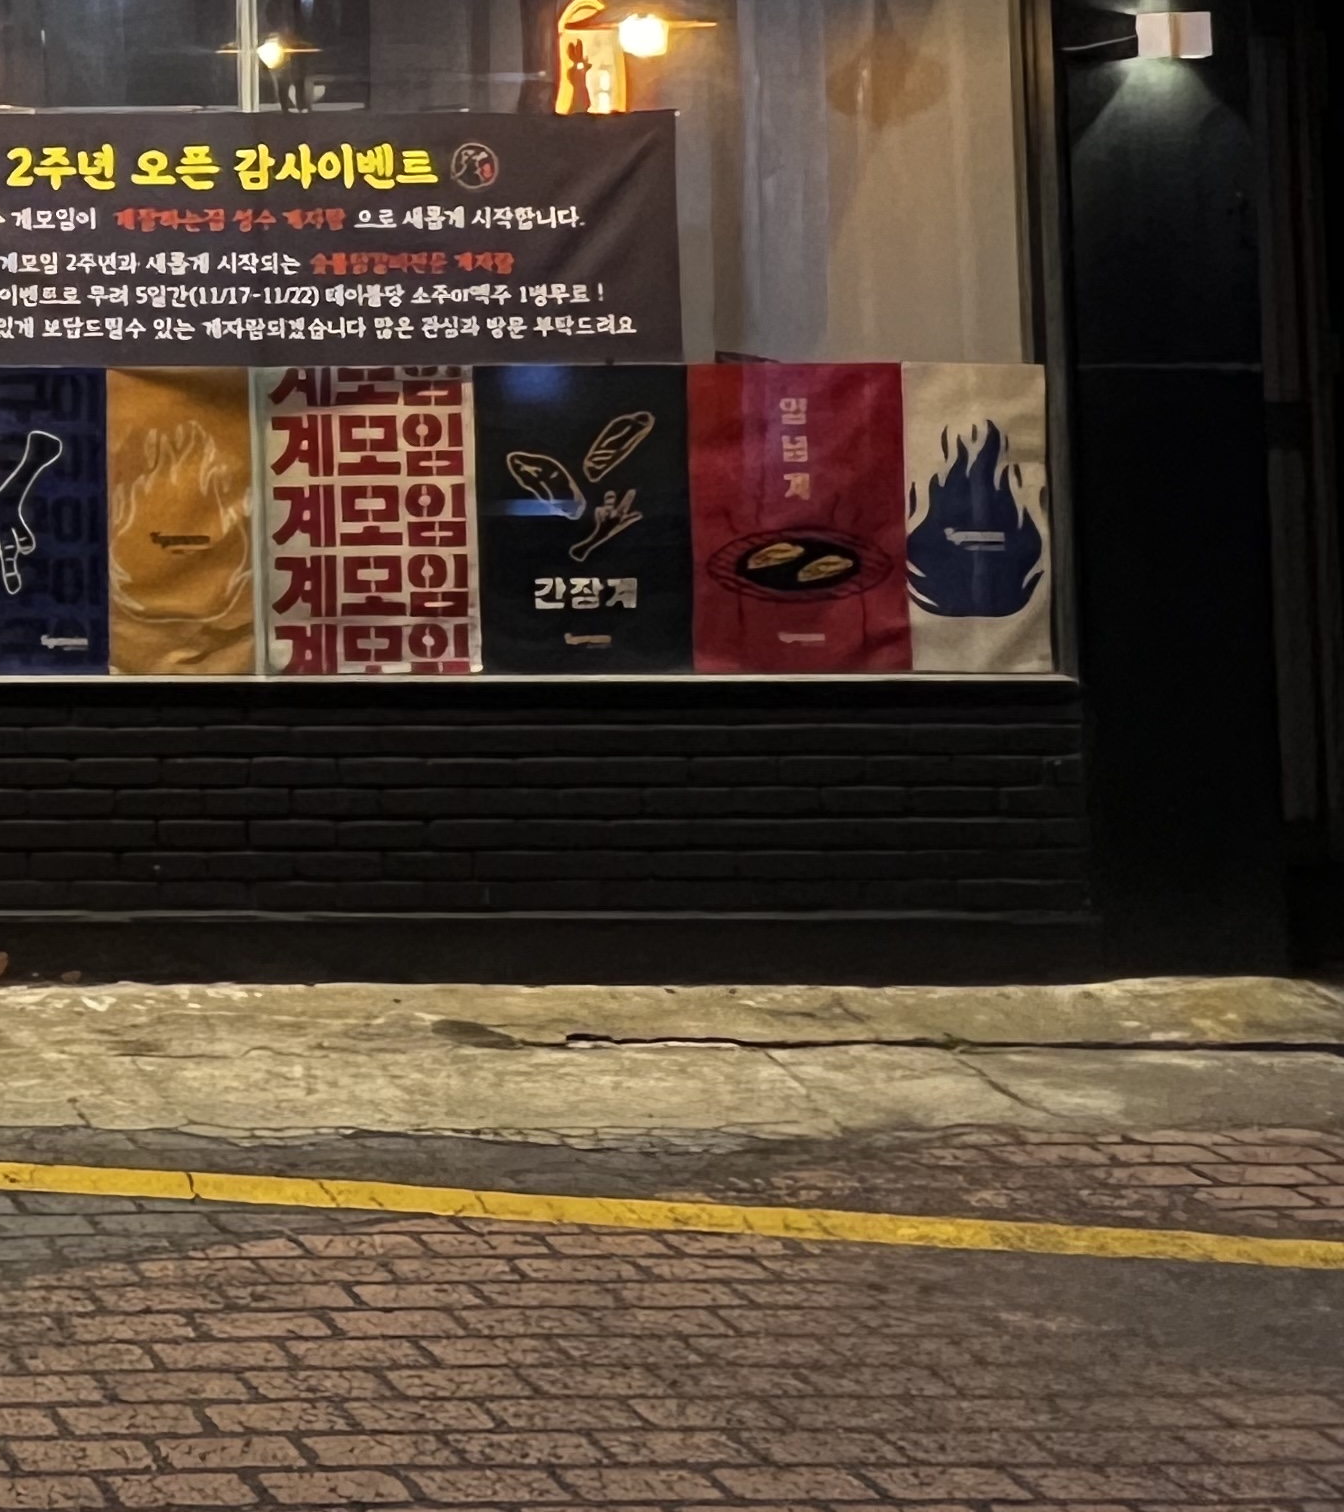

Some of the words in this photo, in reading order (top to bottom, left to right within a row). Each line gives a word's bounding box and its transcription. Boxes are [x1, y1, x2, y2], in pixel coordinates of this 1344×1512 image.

[6, 143, 116, 190] 2주년
[130, 144, 221, 190] 오픈
[233, 143, 439, 190] 감사이벤트
[353, 208, 397, 228] 으로
[402, 205, 465, 231] 새롭게
[471, 205, 587, 231] 시작합니다.
[65, 251, 138, 275] 2주년과
[145, 251, 211, 276] 새롭게
[217, 251, 301, 275] 시작되는
[87, 284, 129, 307] 무려
[325, 283, 406, 308] 테이블당
[152, 316, 196, 340] 있는
[373, 316, 415, 340] 많은
[420, 315, 481, 339] 관심과
[486, 316, 528, 339] 방문
[532, 313, 638, 338] 부탁드려요
[270, 412, 465, 477] 계모임
[271, 483, 468, 547] 계모임
[271, 553, 470, 618] 계모임
[534, 576, 638, 610] 간장계
